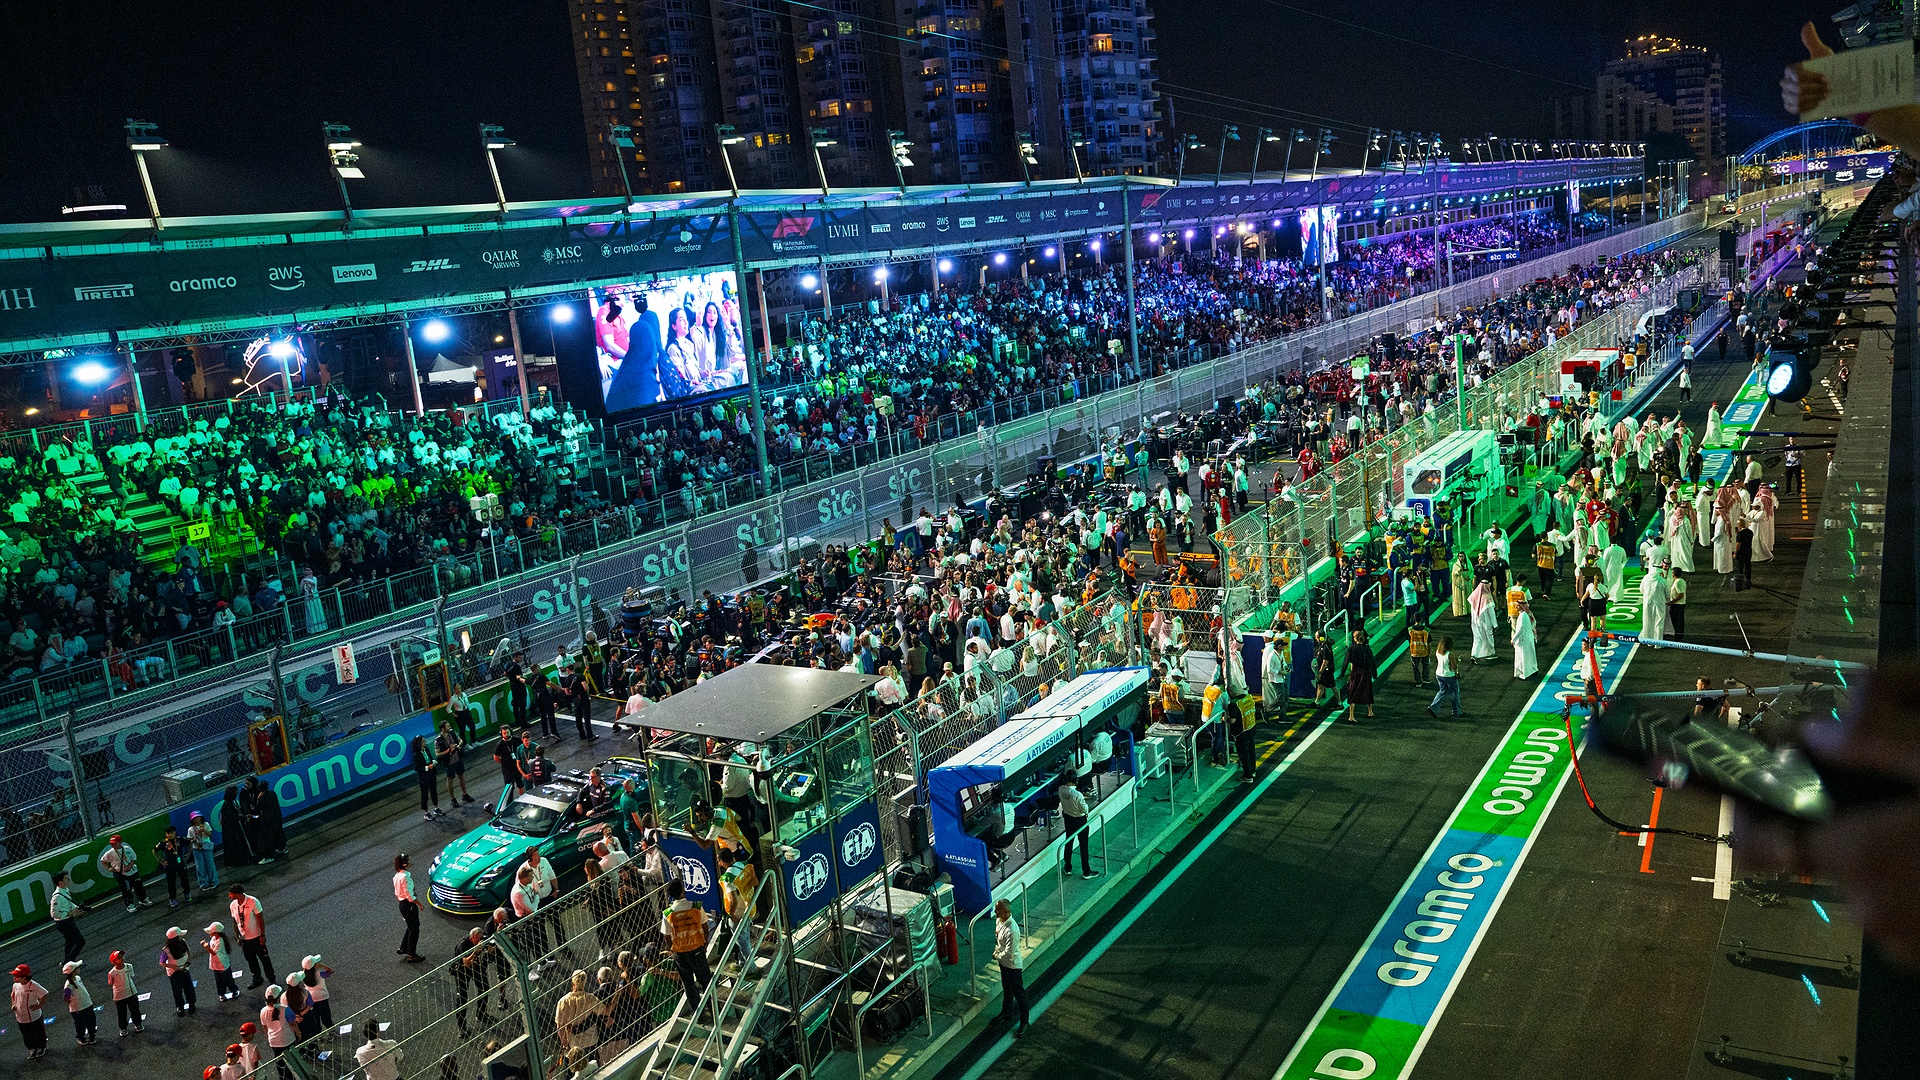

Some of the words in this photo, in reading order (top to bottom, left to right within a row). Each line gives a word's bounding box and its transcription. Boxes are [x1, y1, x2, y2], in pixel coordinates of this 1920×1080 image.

[1807, 160, 1829, 171] stc
[1847, 156, 1869, 167] stc
[1835, 170, 1854, 178] aws
[988, 215, 1005, 223] DHL
[1015, 211, 1031, 220] QATAR
[1045, 210, 1057, 219] MSC
[828, 224, 860, 239] LVMH
[902, 221, 926, 230] aramco
[555, 245, 582, 259] MSC
[613, 242, 657, 255] crypto.com
[673, 243, 702, 254] salesforce
[482, 250, 519, 265] QATAR
[268, 265, 303, 281] aws
[411, 258, 453, 273] DHL
[492, 261, 521, 270] AIRWAYS
[336, 268, 373, 279] Lenovo
[169, 276, 237, 292] aramco
[73, 283, 135, 301] PIRELLI
[888, 466, 921, 500] stc
[818, 488, 857, 523] stc
[193, 527, 205, 537] 17
[737, 513, 780, 551] st
[643, 542, 694, 584] stc
[532, 577, 592, 622] stc
[1105, 680, 1135, 707] ATLASSIAN
[1031, 730, 1065, 758] ATLASSIAN
[1482, 727, 1568, 817] aramco
[1377, 851, 1495, 988] aramco
